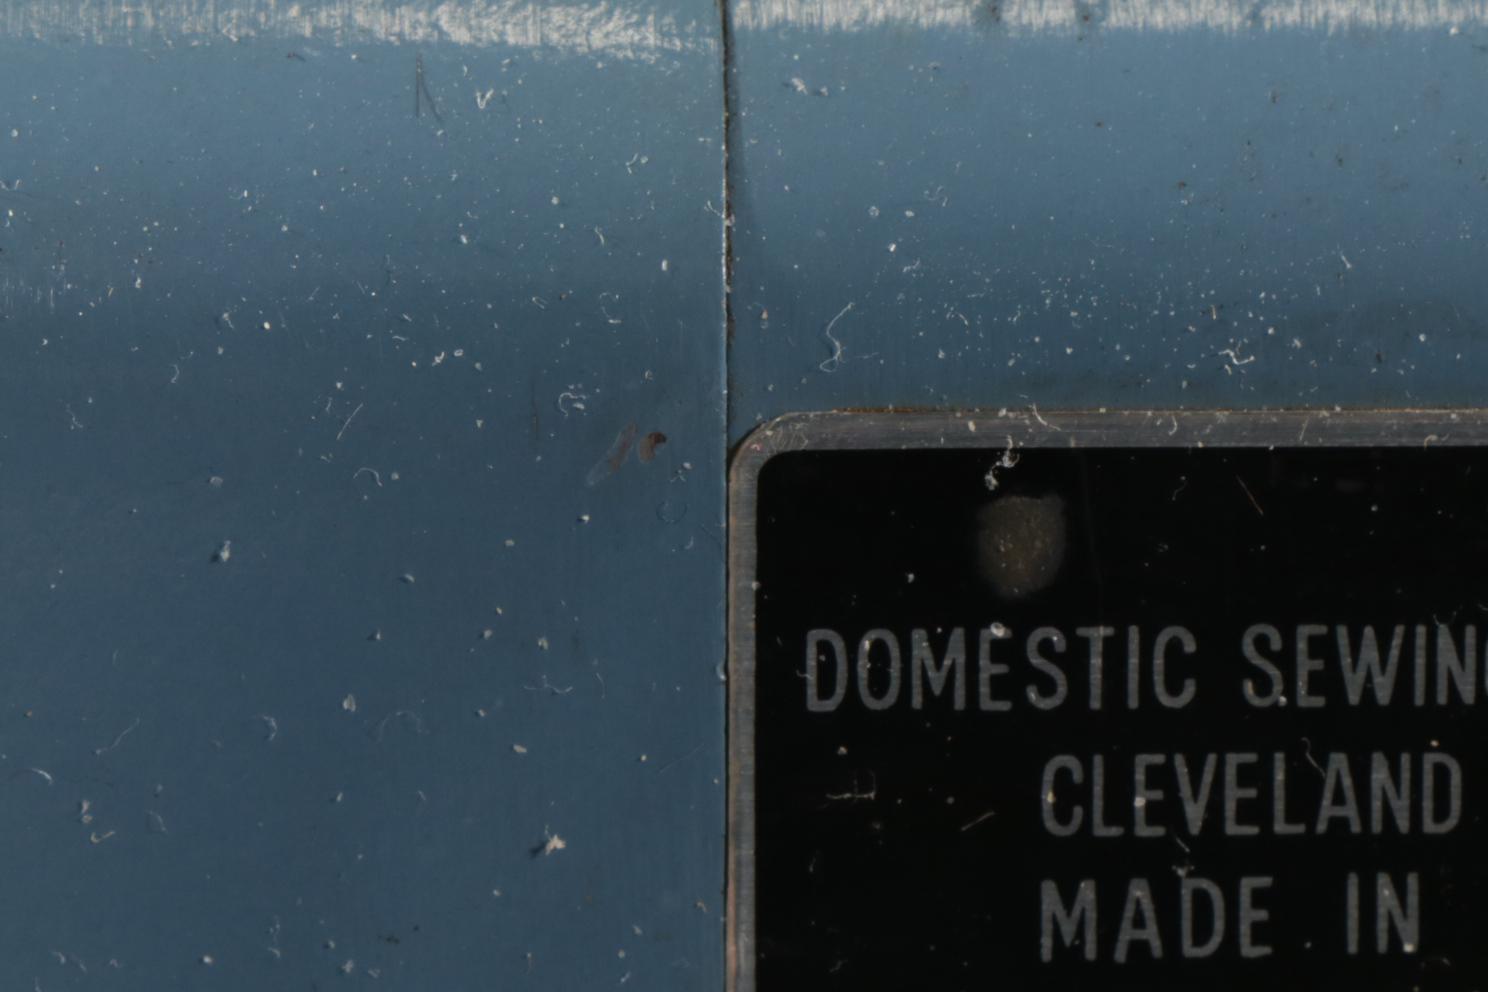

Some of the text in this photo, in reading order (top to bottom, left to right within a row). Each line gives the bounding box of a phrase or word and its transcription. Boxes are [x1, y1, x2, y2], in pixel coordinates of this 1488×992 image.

[804, 624, 1198, 712] DOMESTIC
[1041, 751, 1463, 837] CLEVELAND
[1039, 876, 1274, 964] MADE
[1345, 871, 1421, 956] IN
